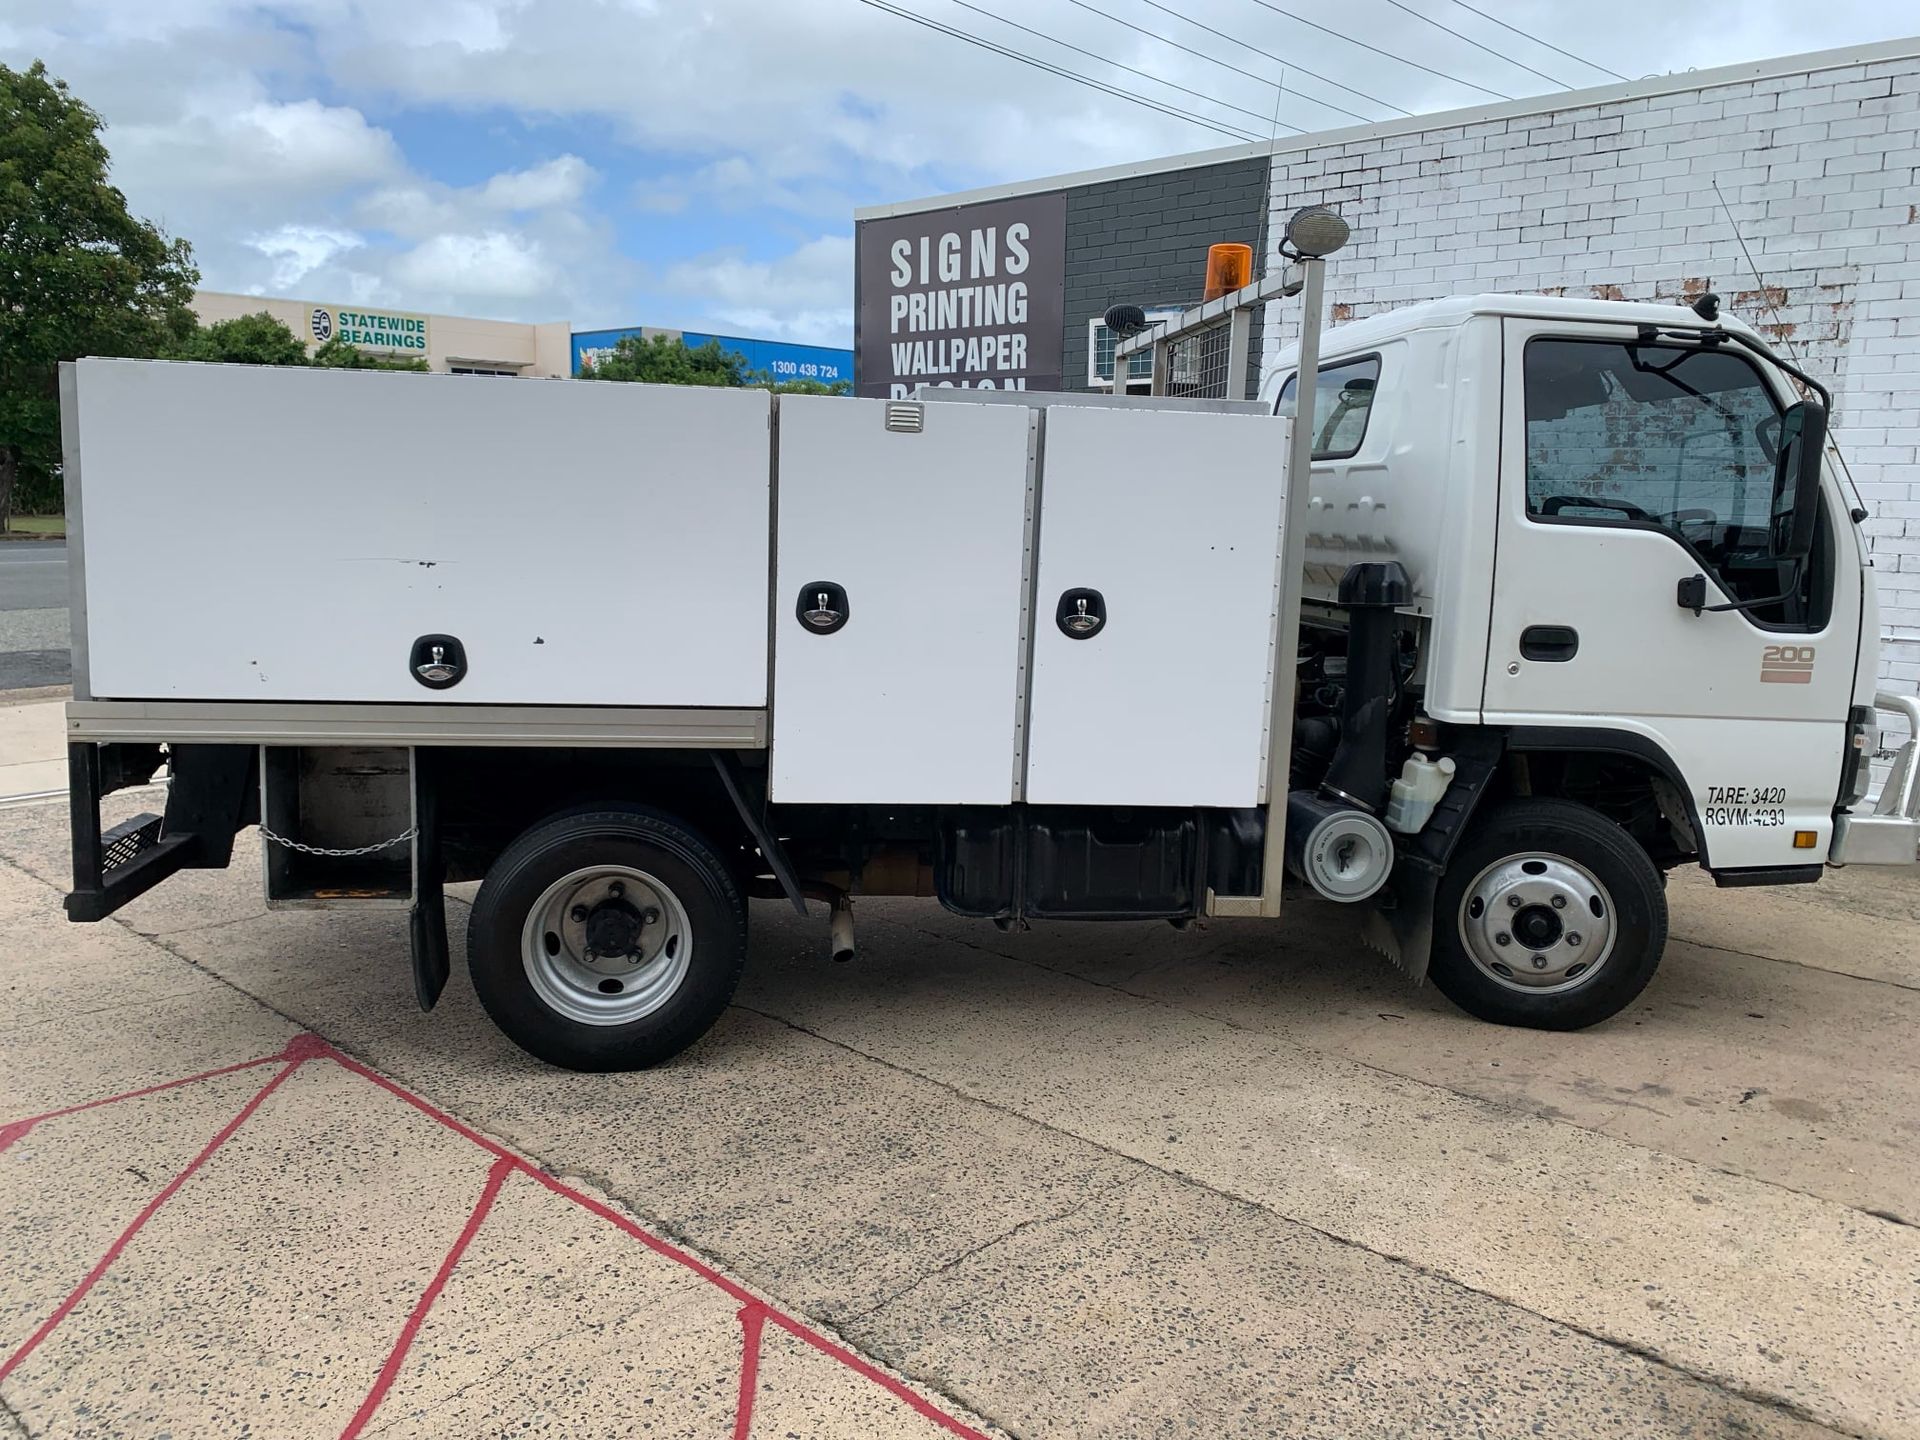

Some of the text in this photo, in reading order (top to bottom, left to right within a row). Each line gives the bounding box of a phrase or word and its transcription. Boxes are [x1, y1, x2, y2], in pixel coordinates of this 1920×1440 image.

[890, 222, 1030, 288] SIGNS
[891, 281, 1028, 334] PRINTING
[339, 312, 425, 333] STATEWIDE
[340, 329, 425, 349] BEARINGS
[891, 333, 1027, 376] WALLPAPER
[772, 360, 838, 378] 1300 438 724
[1762, 645, 1816, 663] 200
[1708, 786, 1786, 805] TARE: 3420
